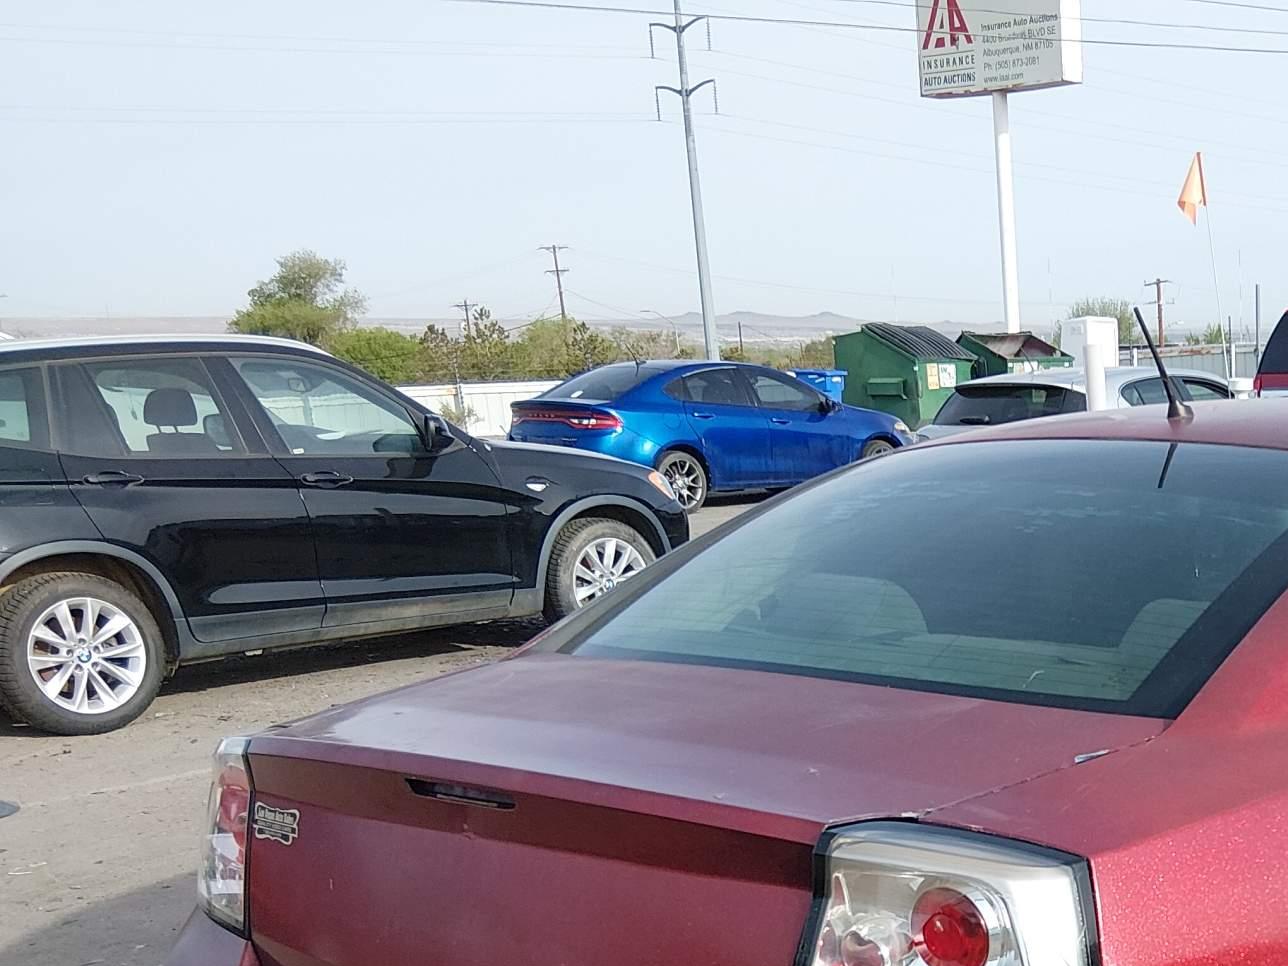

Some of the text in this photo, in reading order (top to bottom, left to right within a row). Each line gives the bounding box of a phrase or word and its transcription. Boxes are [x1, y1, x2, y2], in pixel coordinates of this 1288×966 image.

[981, 14, 1058, 31] Insurance Auto Auctions
[1027, 26, 1045, 38] BLVD
[1046, 25, 1057, 35] SE
[1022, 42, 1034, 52] NM
[1034, 39, 1054, 50] 87105
[922, 55, 976, 71] INSURANCE
[923, 71, 976, 87] AUTO AUCTIONS
